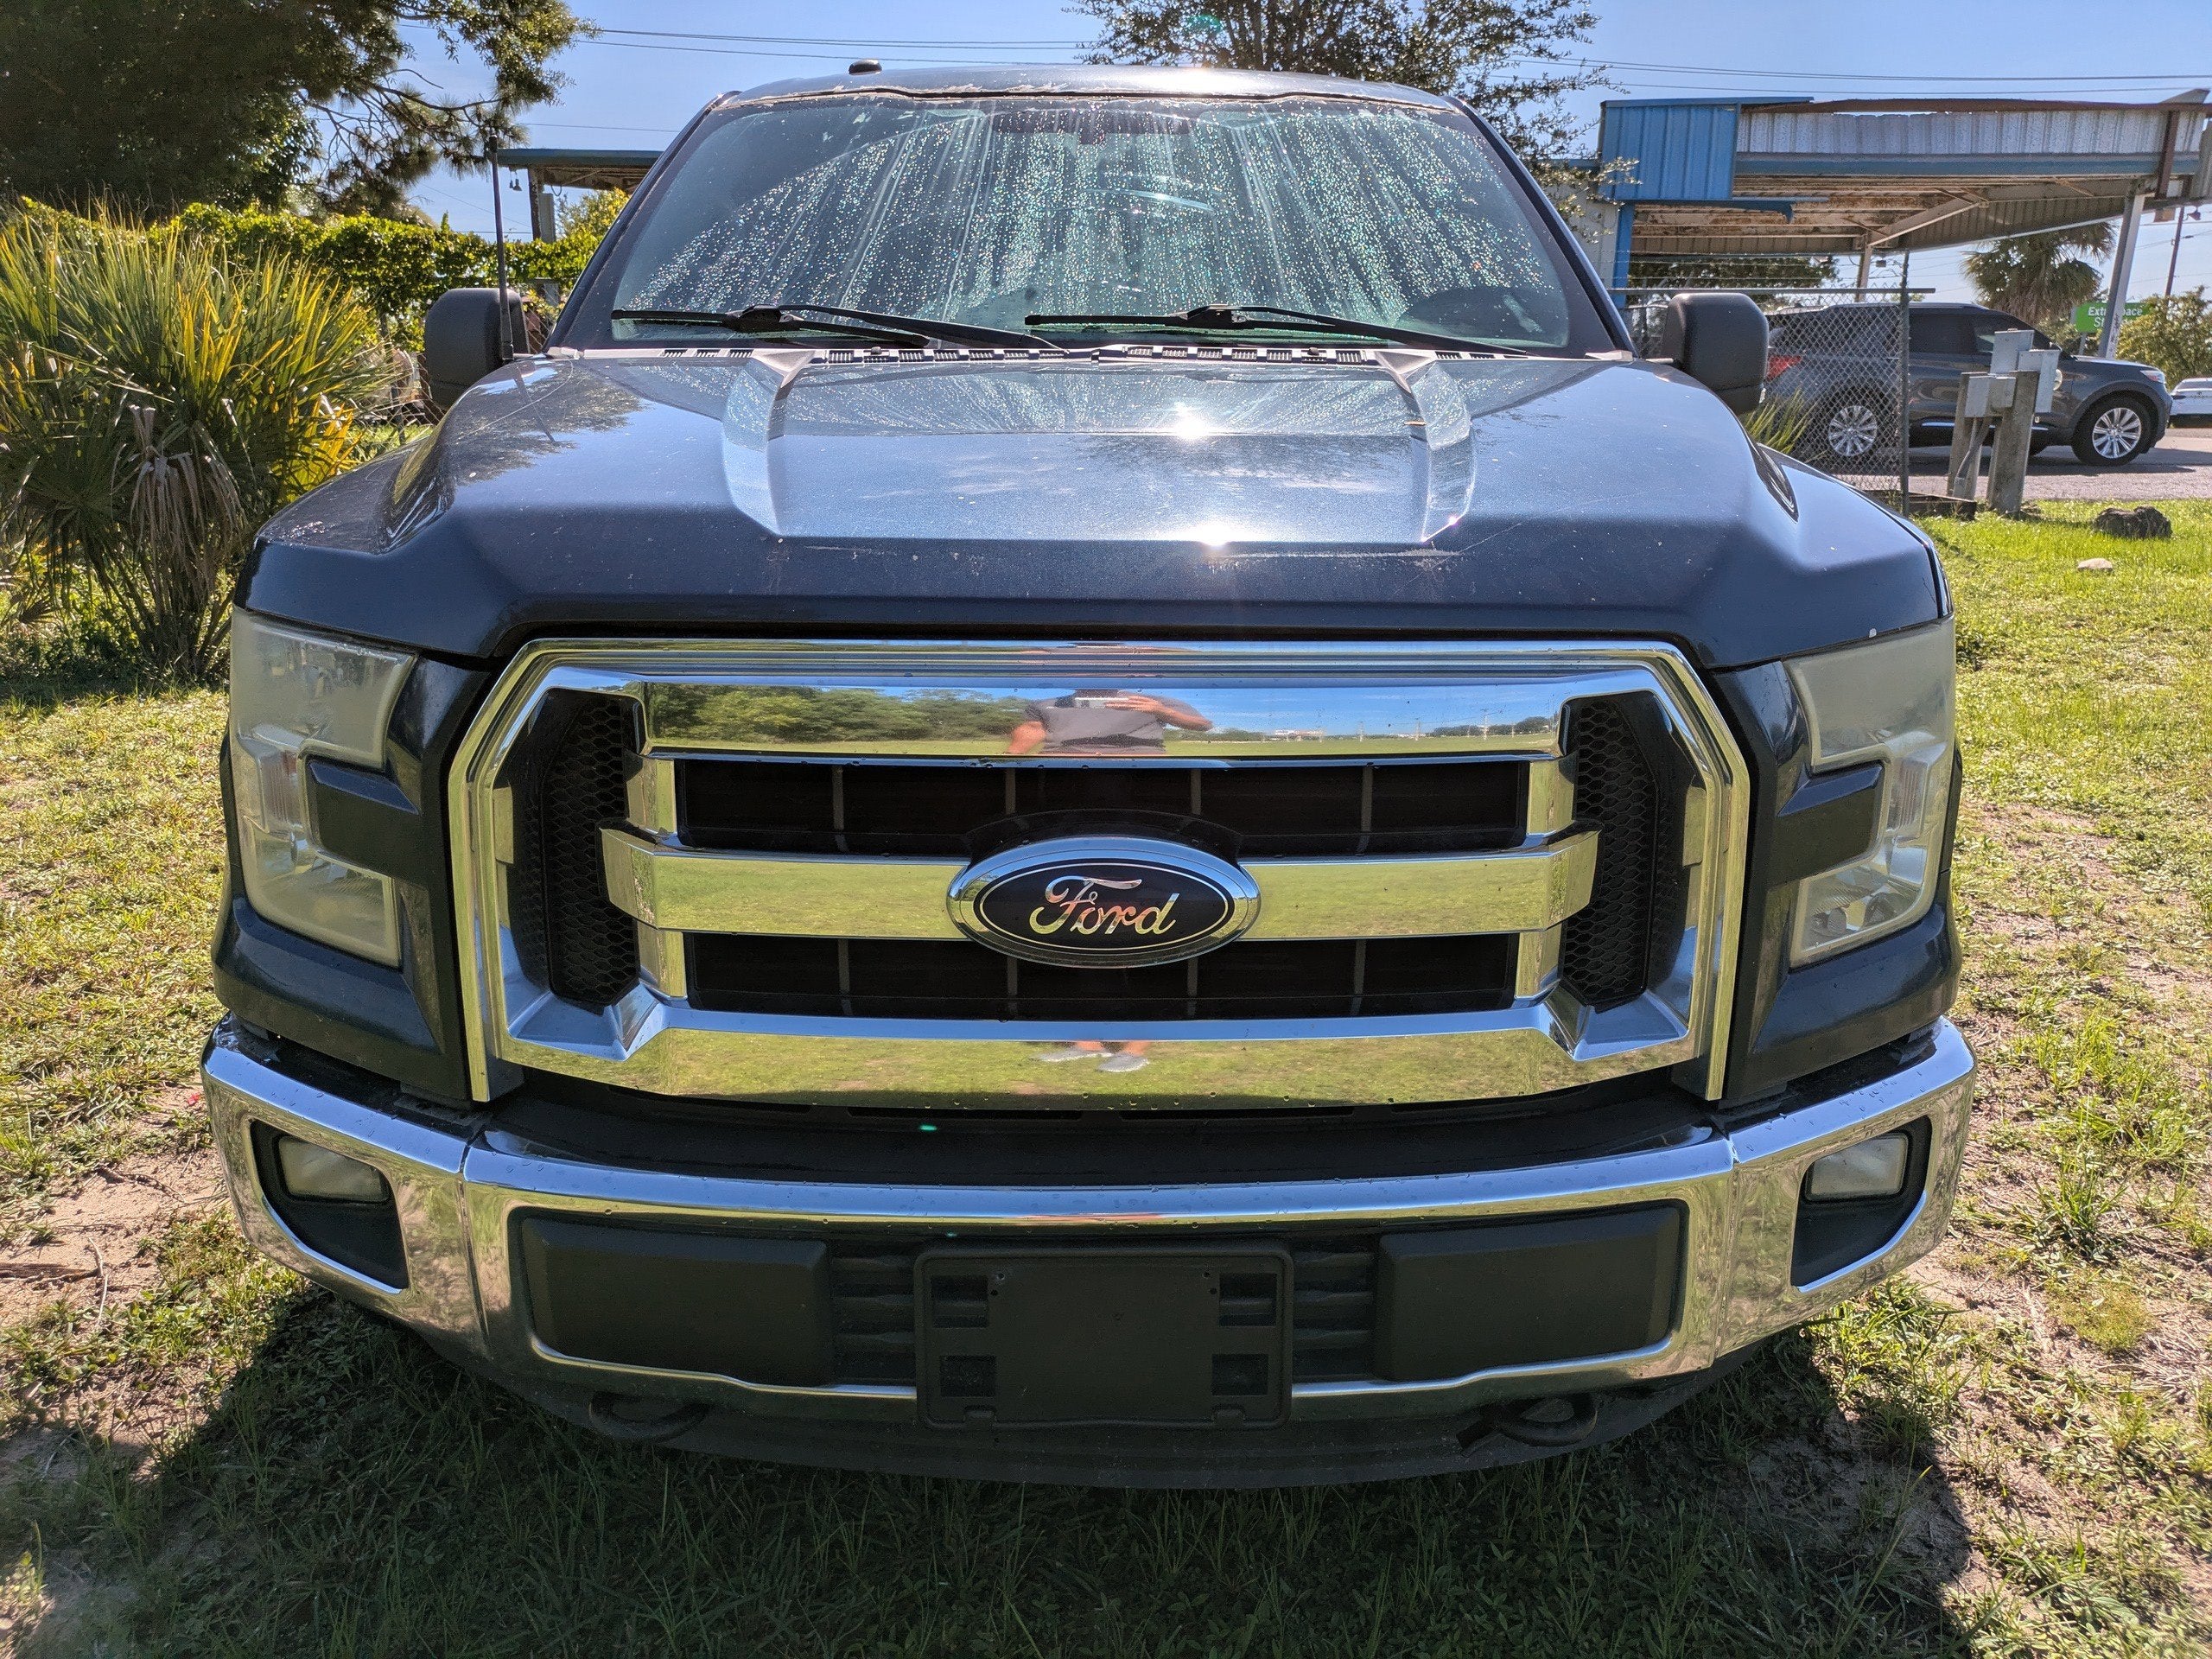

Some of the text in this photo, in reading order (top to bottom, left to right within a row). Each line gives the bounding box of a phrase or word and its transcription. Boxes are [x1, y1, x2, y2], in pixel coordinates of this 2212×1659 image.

[2088, 307, 2143, 316] Ext ace
[1029, 875, 1179, 935] Ford
